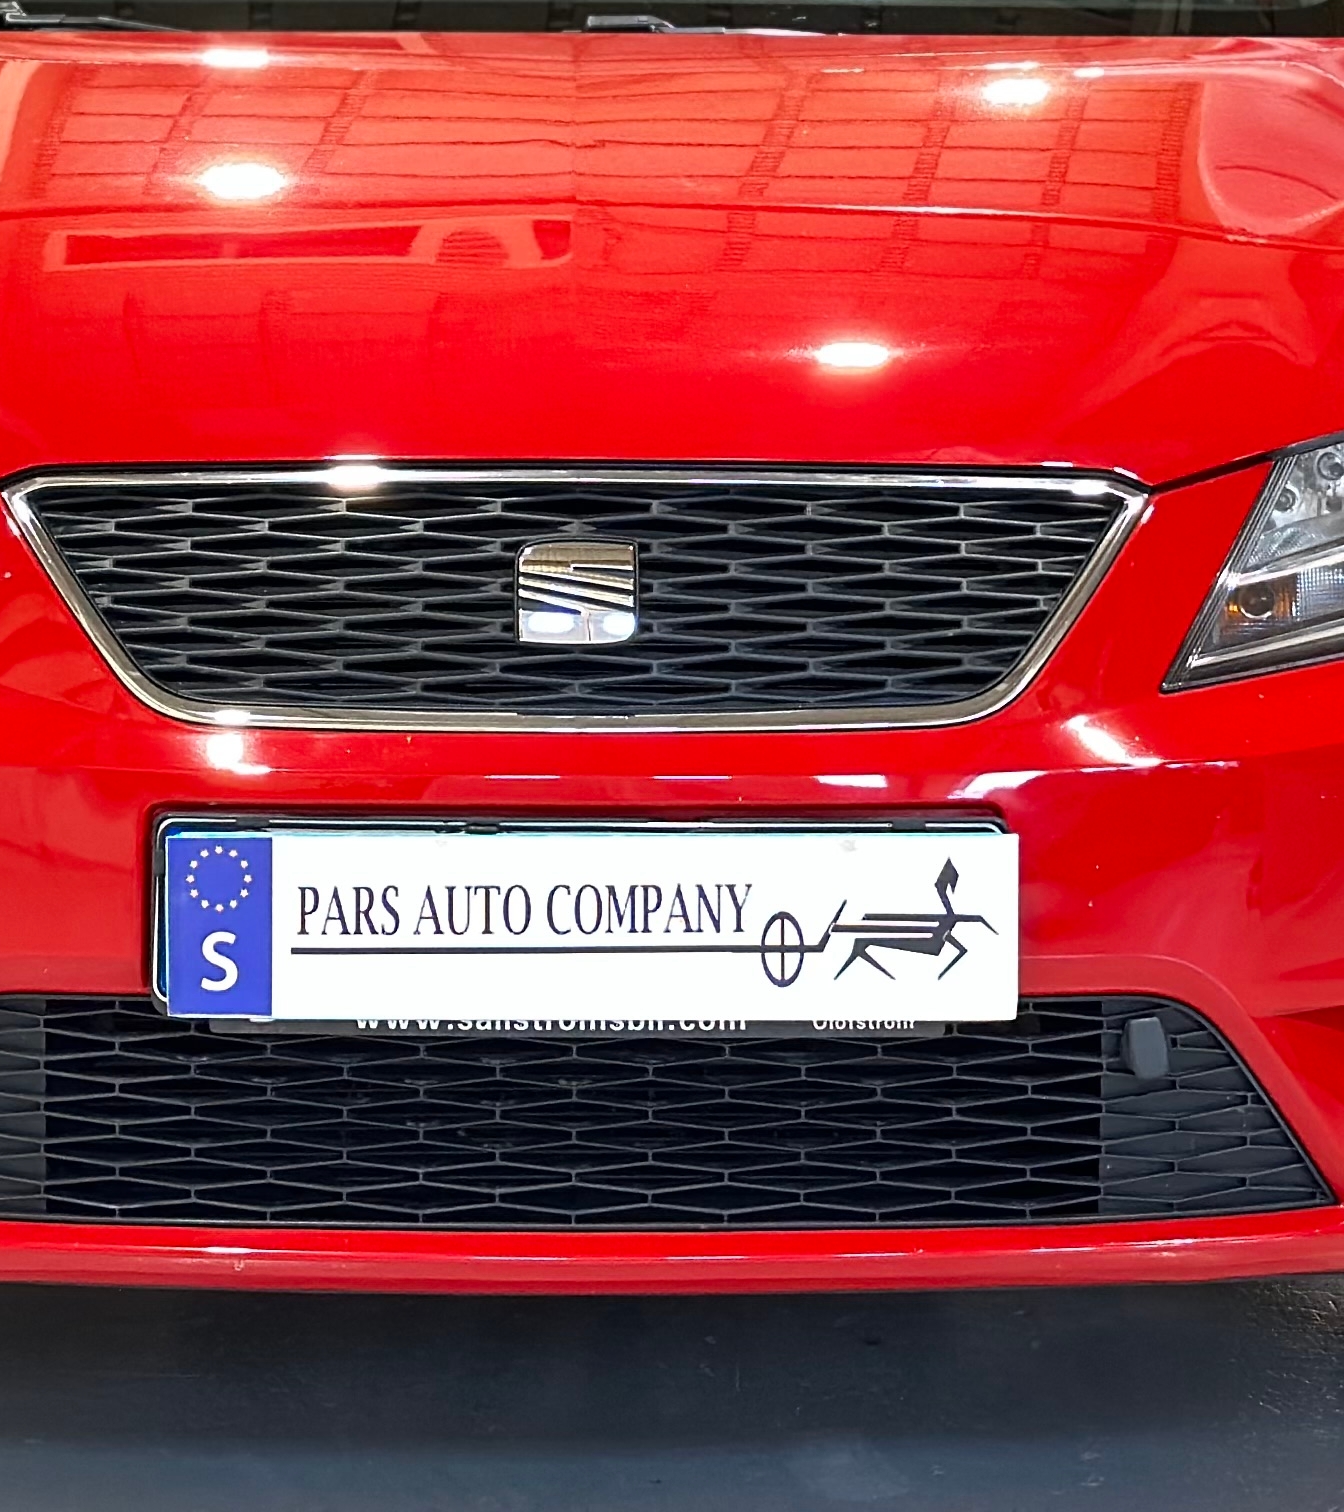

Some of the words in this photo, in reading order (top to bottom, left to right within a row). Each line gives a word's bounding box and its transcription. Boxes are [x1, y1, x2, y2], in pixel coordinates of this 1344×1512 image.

[297, 885, 400, 936] PARS
[413, 884, 532, 936] AUTO
[546, 883, 753, 936] COMPANY
[199, 931, 239, 992] S
